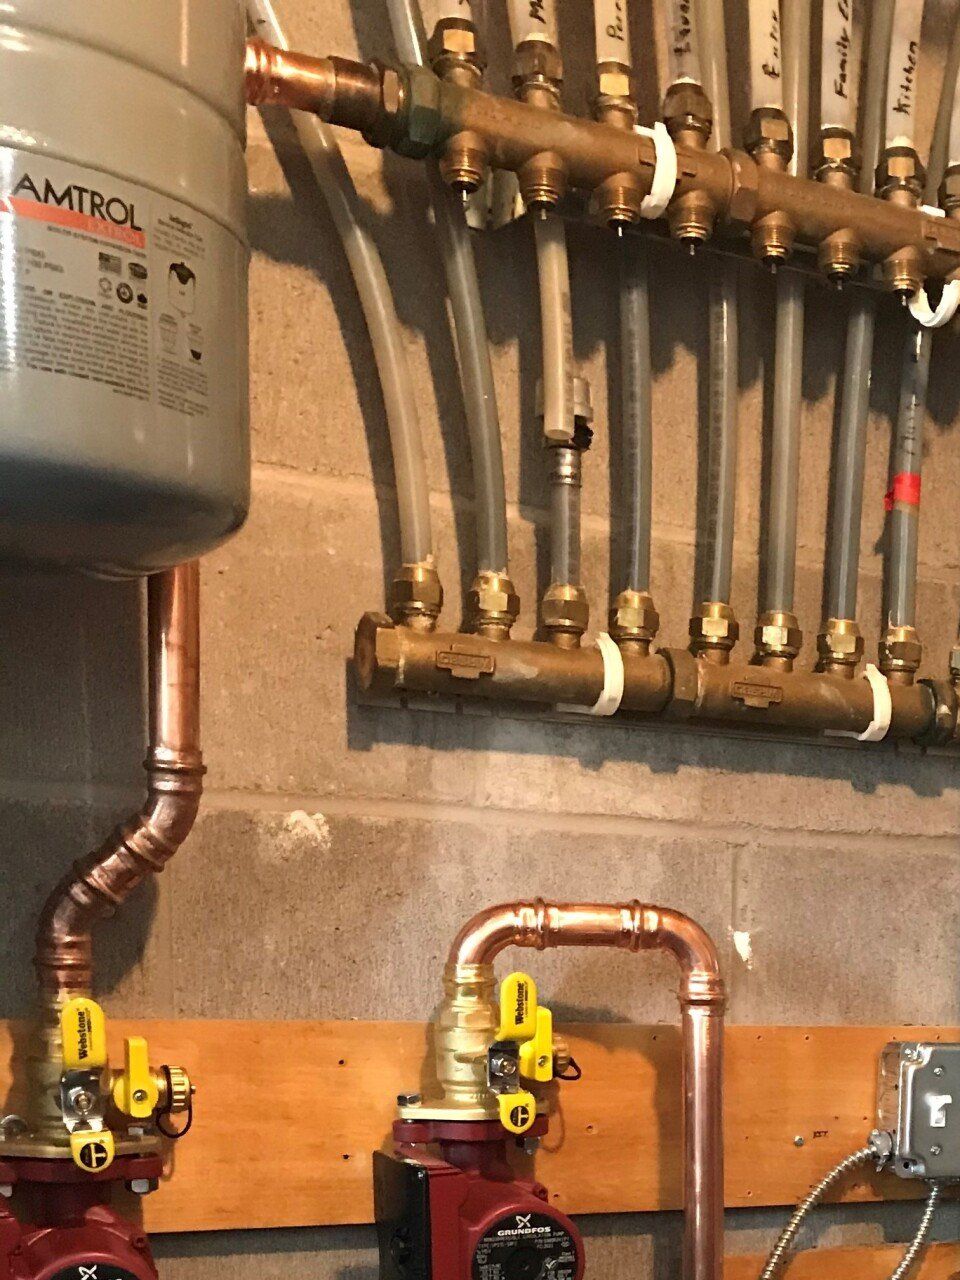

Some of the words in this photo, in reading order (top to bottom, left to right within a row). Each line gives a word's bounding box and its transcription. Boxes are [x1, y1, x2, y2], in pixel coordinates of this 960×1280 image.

[834, 28, 850, 99] Family
[892, 41, 917, 116] Kitchen
[13, 173, 143, 232] AMTROL
[515, 981, 525, 1025] Webstone
[78, 1010, 88, 1060] Webstone
[497, 1226, 551, 1236] GRUNDFOS
